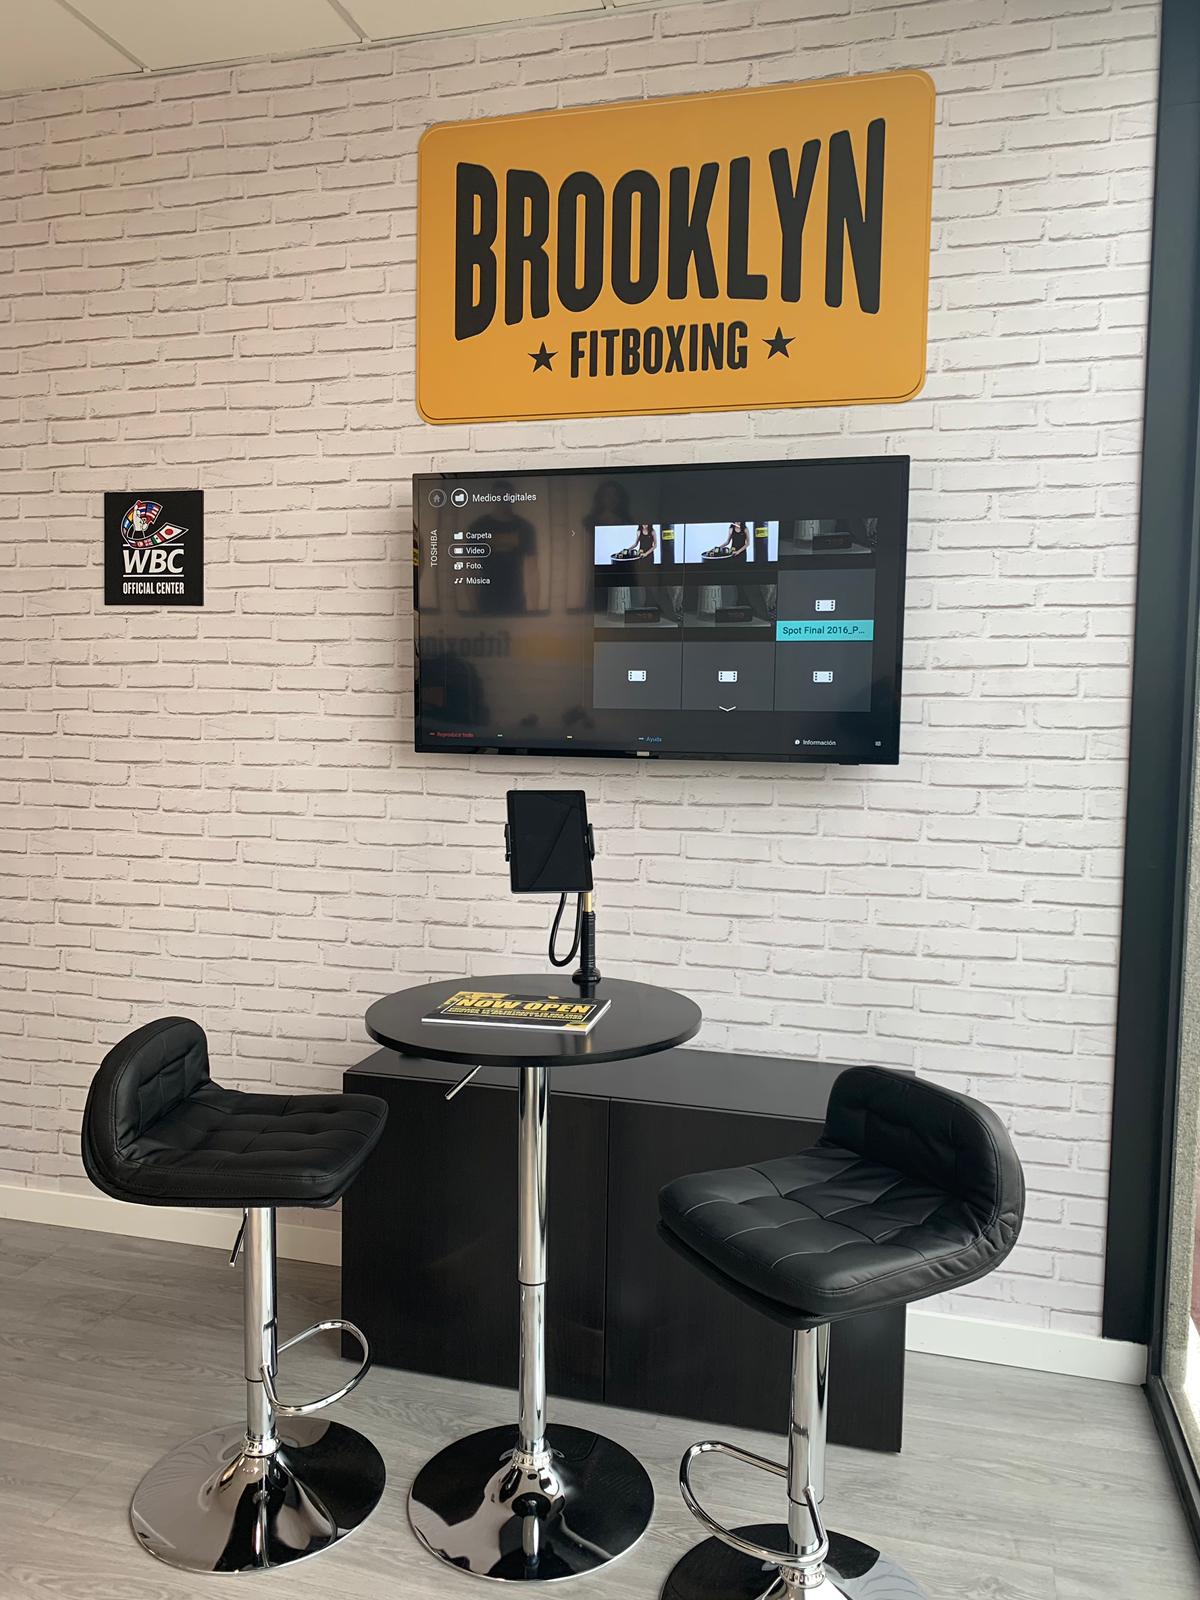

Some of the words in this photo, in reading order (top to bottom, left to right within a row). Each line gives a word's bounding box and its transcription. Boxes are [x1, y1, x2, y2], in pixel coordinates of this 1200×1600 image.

[455, 118, 886, 341] BROOKLYN
[570, 321, 748, 378] FITBOXING
[472, 493, 502, 502] Medios
[503, 493, 537, 503] digitales
[465, 532, 492, 541] Carpeta
[430, 529, 438, 567] TOSHIBA
[123, 549, 184, 573] WBC
[465, 577, 491, 585] Música
[123, 582, 155, 594] OFFICIAL
[156, 582, 184, 594] CENTER
[782, 627, 802, 636] Spot
[804, 626, 825, 634] Final
[456, 999, 521, 1009] NOW
[523, 1002, 591, 1014] OPEN
